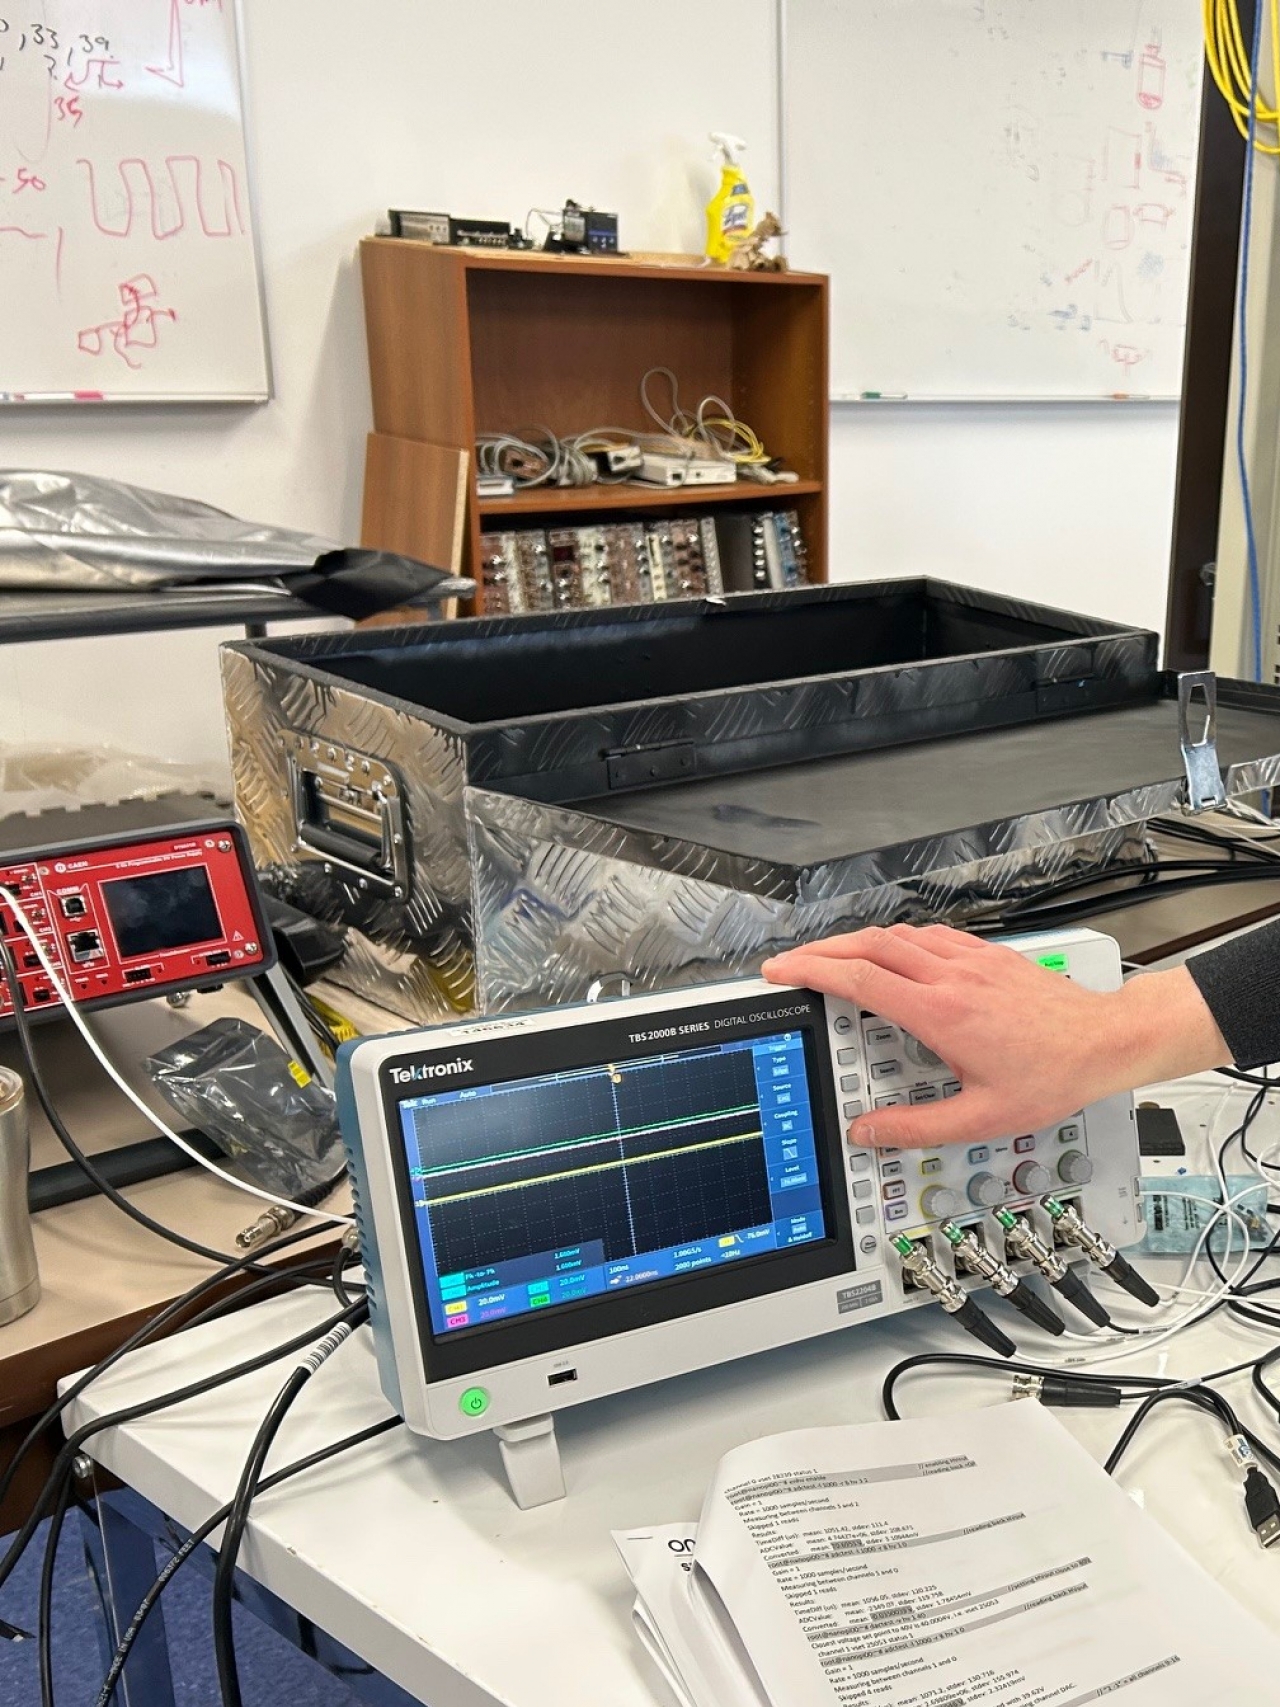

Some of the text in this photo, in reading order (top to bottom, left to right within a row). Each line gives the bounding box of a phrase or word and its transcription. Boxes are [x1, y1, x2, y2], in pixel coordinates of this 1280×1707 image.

[628, 1004, 811, 1044] TBS 2000B SERIES DIGITAL OSCILLOSCOPE
[772, 1056, 786, 1065] Type
[389, 1058, 474, 1084] Tektronix
[772, 1081, 791, 1091] Source
[460, 1091, 477, 1099] Auto
[774, 1109, 798, 1120] Coupling
[781, 1138, 797, 1147] Slope
[785, 1164, 800, 1174] Level
[691, 1256, 712, 1268] points
[467, 1280, 500, 1293] Amplitude
[450, 1315, 466, 1326] CH3
[743, 1513, 779, 1524] Measuring
[779, 1508, 808, 1517] between
[809, 1504, 836, 1513] channels
[747, 1517, 799, 1531] Skipped reads
[781, 1567, 893, 1592] Measuring between channels and
[785, 1589, 812, 1600] Skipped
[811, 1640, 837, 1650] Closest
[837, 1635, 862, 1645] voltage
[873, 1628, 891, 1638] point
[818, 1647, 846, 1658] channel
[824, 1667, 842, 1676] Gain
[829, 1657, 924, 1684] Rate 1000 samples/second
[833, 1658, 951, 1694] Measuring between channels and
[1137, 1663, 1164, 1677] channels
[970, 1680, 990, 1691] stdev:
[838, 1684, 893, 1701] Skipped reads
[897, 1697, 919, 1706] mean:
[945, 1681, 966, 1691] stdev:
